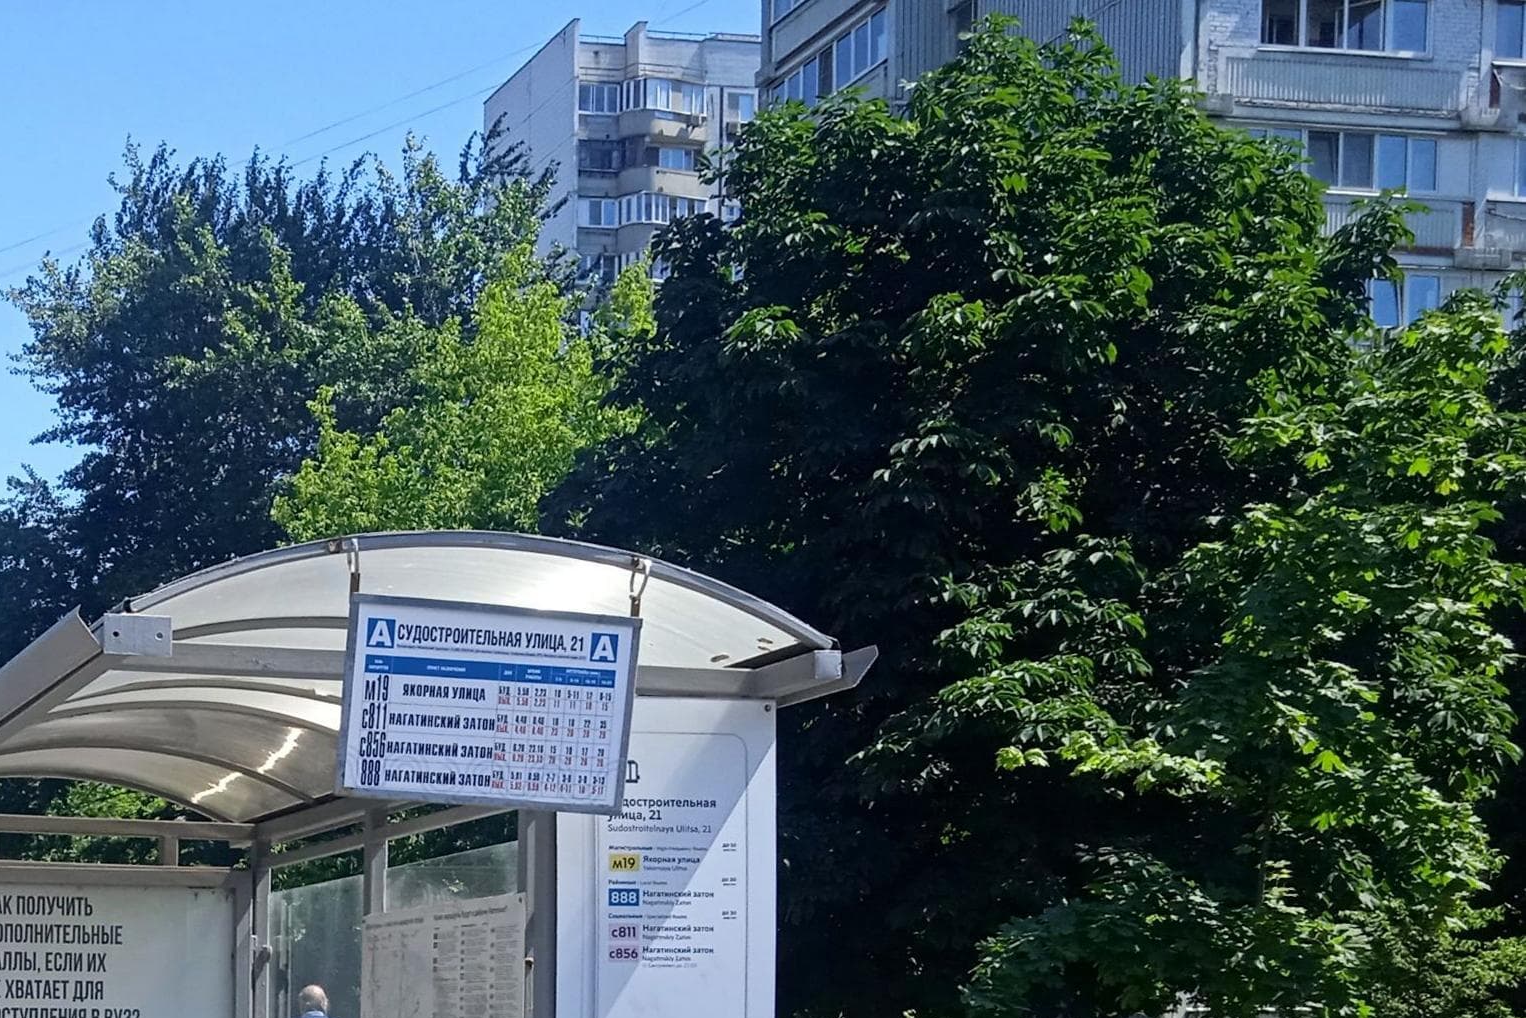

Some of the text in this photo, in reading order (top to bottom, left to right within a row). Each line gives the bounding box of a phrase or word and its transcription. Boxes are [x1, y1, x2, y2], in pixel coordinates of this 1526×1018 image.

[368, 620, 392, 647] А
[397, 624, 522, 648] СУДОСТРОИТЕЛЬНАЯ
[525, 632, 567, 652] УЛИЦА,
[570, 636, 584, 651] 21
[402, 684, 449, 699] ЯКОРНАЯ
[452, 687, 486, 702] УЛИЦА
[389, 713, 461, 729] НАГАТИНСКИЙ
[463, 717, 495, 731] ЗАТОН
[386, 741, 458, 757] НАГАТИНСКИЙ
[460, 745, 493, 759] ЗАТОН
[360, 759, 491, 787] 888 НАГАТИНСКИЙ ЗАТОН
[622, 798, 717, 808] достроительная
[649, 810, 662, 821] 21
[702, 825, 712, 833] 21
[612, 857, 636, 869] м19
[643, 856, 676, 864] Якорная
[611, 891, 637, 904] 888
[642, 890, 692, 898] Нагатинский
[16, 895, 93, 916] ПОЛУЧИТЬ
[611, 926, 636, 938] с811
[642, 924, 692, 932] Нагатинский
[609, 948, 638, 959] с856
[642, 946, 692, 954] Нагатинский
[45, 952, 83, 972] ЕСЛИ
[87, 953, 107, 973] ИХ
[5, 979, 69, 1000] ХВАТАЕТ
[72, 980, 104, 1002] ДЛЯ
